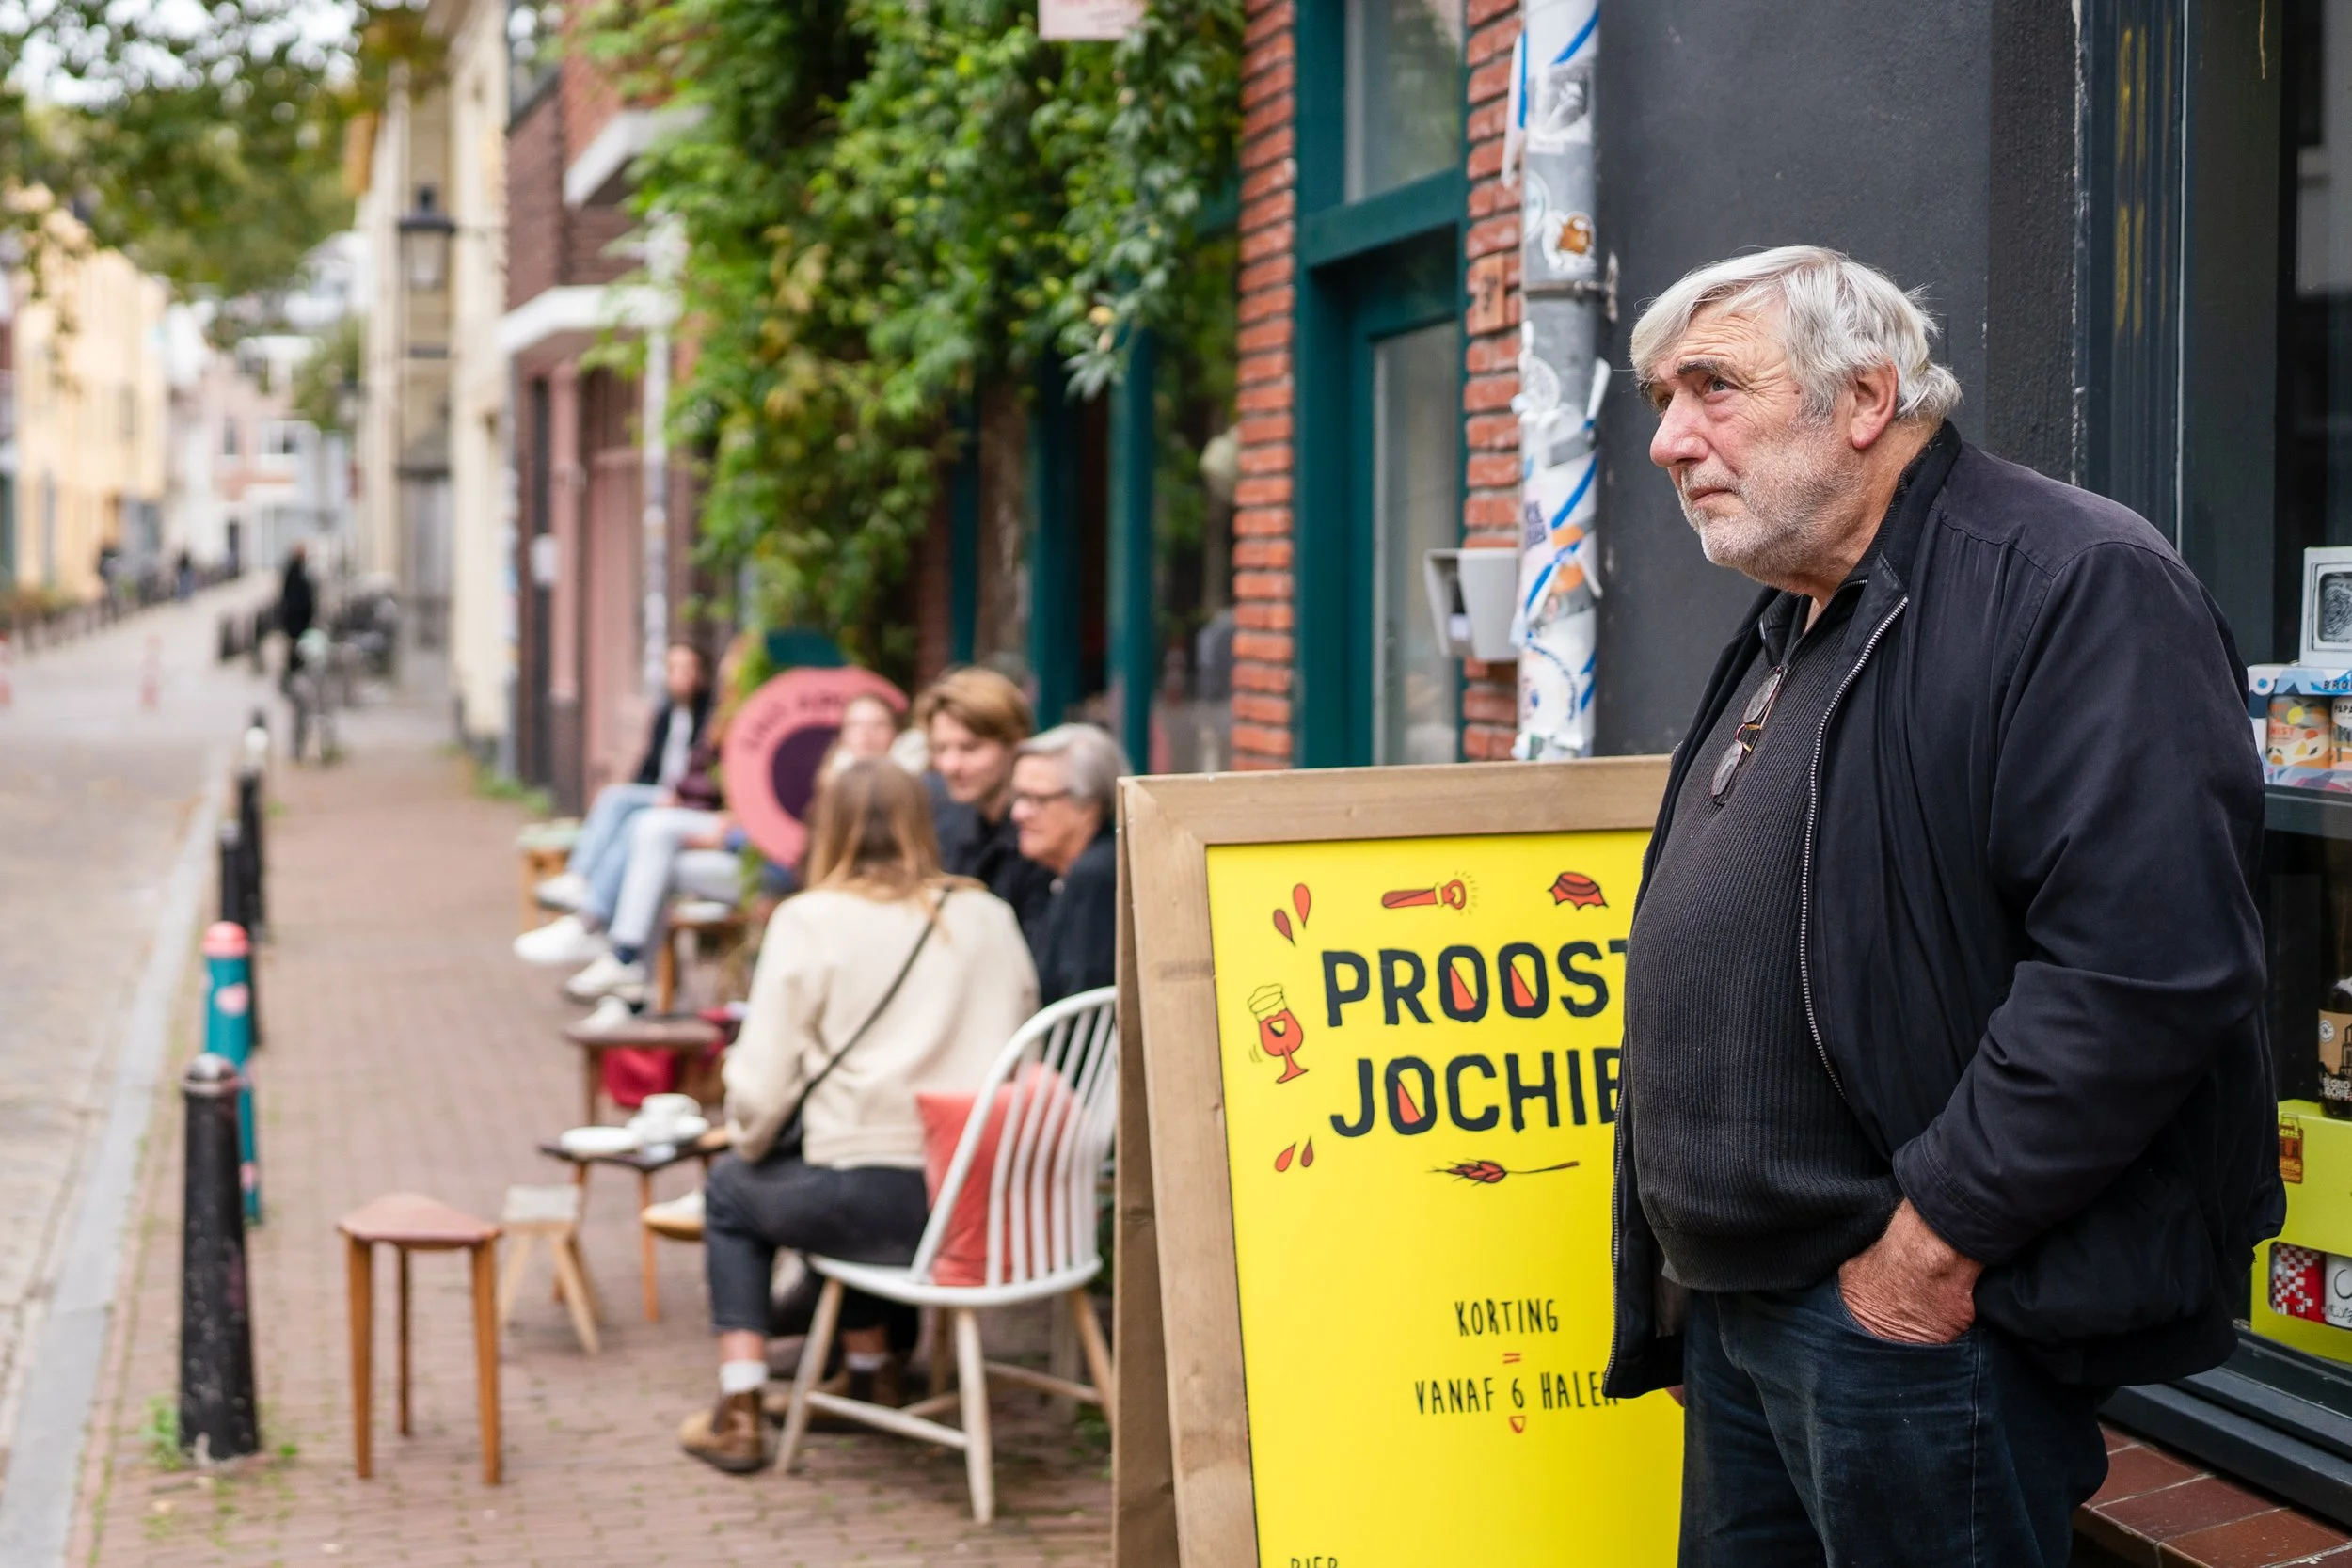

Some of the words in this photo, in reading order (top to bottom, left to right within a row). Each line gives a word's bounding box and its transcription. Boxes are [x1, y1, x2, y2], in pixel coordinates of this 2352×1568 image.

[2323, 679, 2352, 689] BRO
[1454, 1298, 1559, 1336] KORTING
[1415, 1377, 1495, 1415] VANAF
[1511, 1377, 1524, 1409] 6
